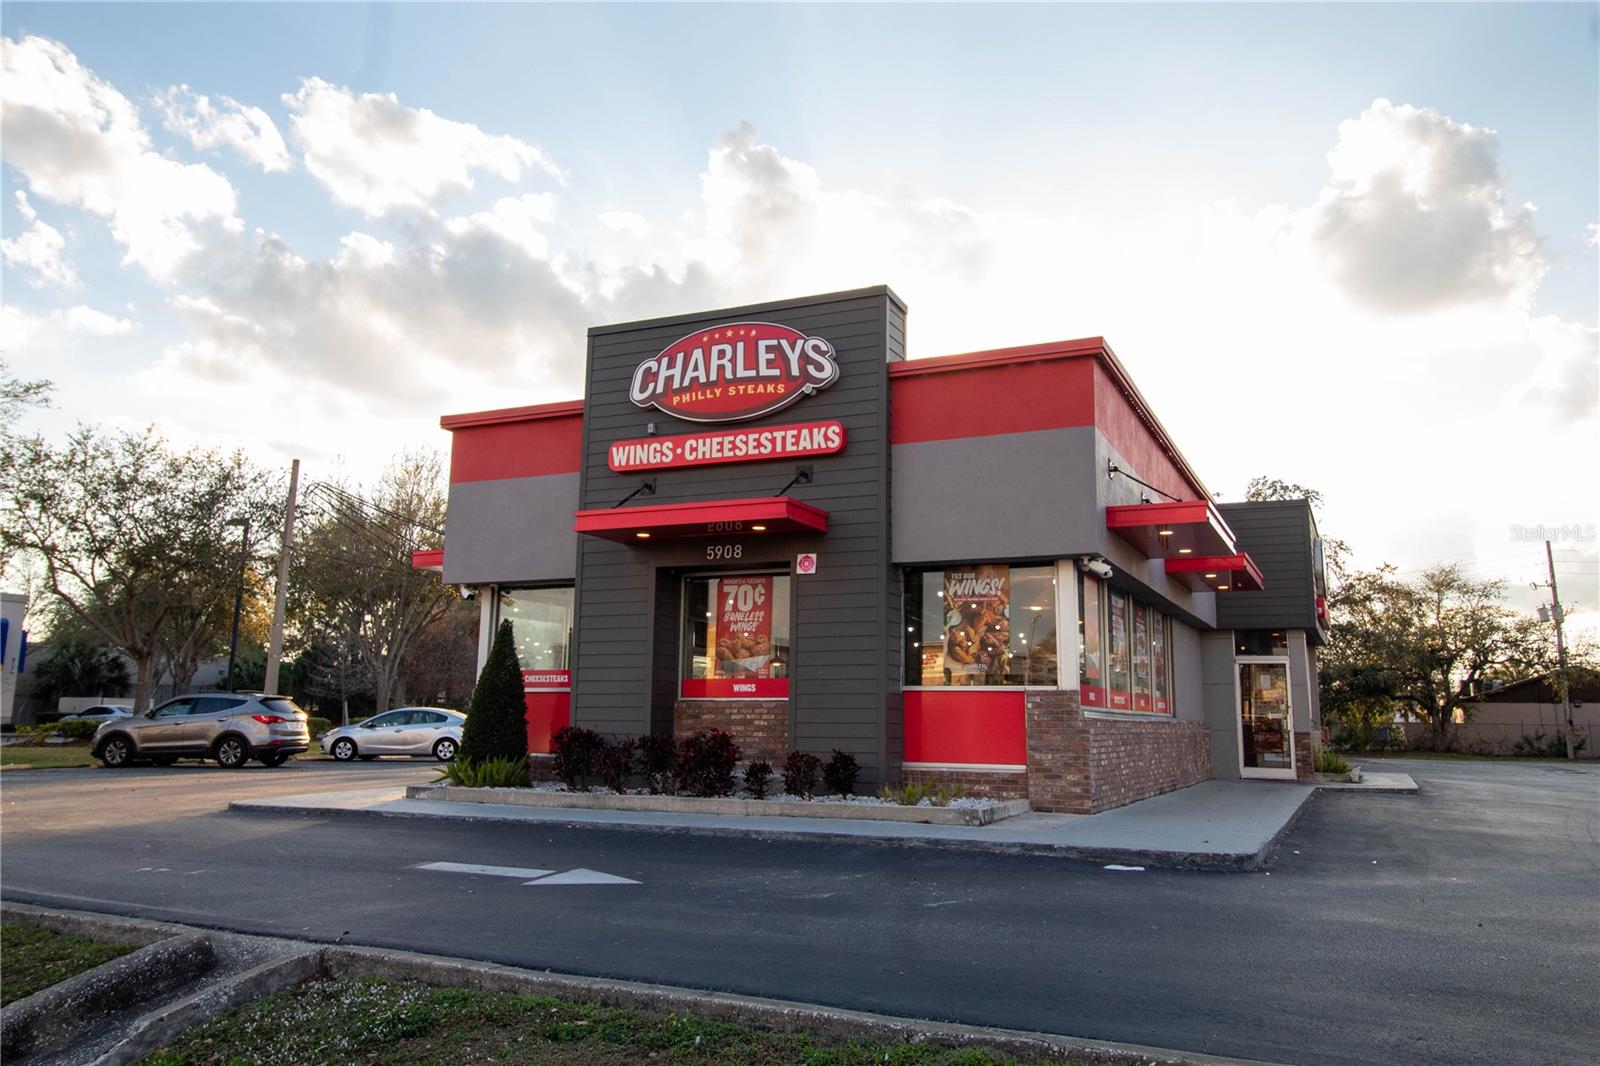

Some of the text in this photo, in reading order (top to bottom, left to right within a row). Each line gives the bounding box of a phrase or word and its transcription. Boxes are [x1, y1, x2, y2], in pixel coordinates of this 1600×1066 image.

[632, 339, 834, 401] CHARLEYS
[672, 383, 786, 405] PHILLY STEAKS
[612, 425, 840, 467] WINGS CHEESESTEAKS
[706, 544, 742, 560] 5908
[949, 576, 1006, 596] WINGS!
[723, 584, 766, 612] 70¢
[723, 611, 765, 622] BONELESS
[525, 674, 569, 683] CHEESESTEAKS
[732, 683, 757, 693] WINGS
